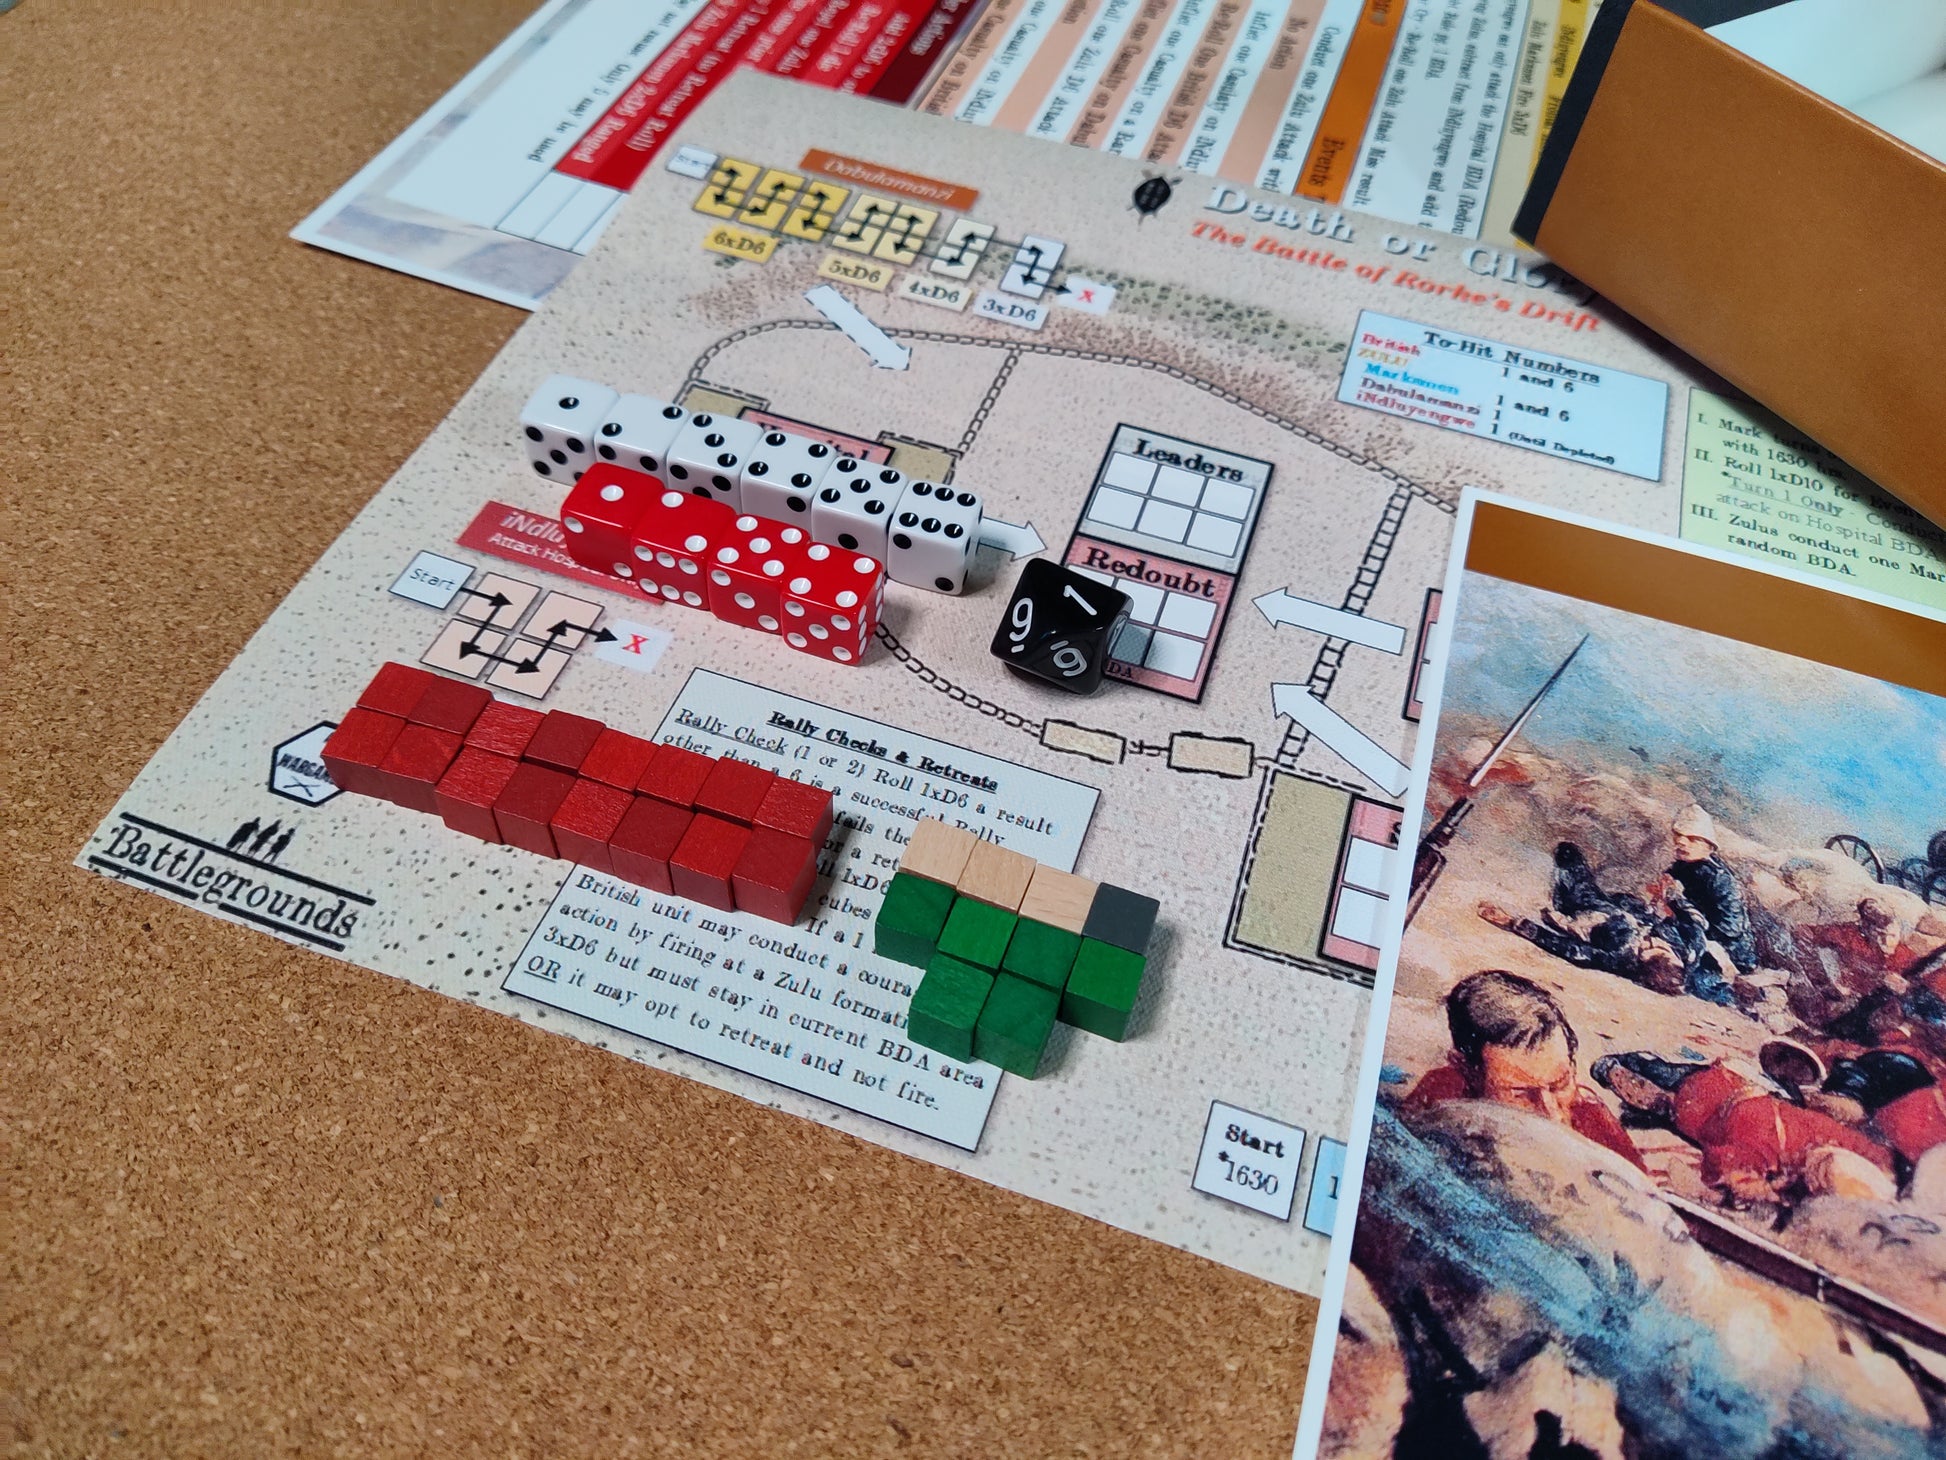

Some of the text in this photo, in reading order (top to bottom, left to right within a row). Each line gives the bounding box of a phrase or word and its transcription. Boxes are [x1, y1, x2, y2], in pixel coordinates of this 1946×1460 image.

[823, 156, 955, 201] Dabulamanzi
[1421, 195, 1438, 216] add
[1203, 183, 1355, 244] Death
[1381, 231, 1437, 263] or
[713, 232, 766, 256] 6xD6
[828, 260, 880, 284] 5xD6
[1191, 220, 1604, 333] The Battle of Rorke's Drift
[908, 281, 960, 304] 4xD6
[982, 298, 1036, 324] 3xD6
[1363, 333, 1419, 355] British
[1520, 374, 1553, 387] and
[1563, 381, 1573, 392] 6
[1504, 350, 1599, 383] Numbers
[1514, 402, 1548, 416] and
[1559, 410, 1569, 421] 6
[1717, 418, 1762, 439] Mark
[1132, 438, 1244, 483] Leaders
[1722, 439, 1758, 455] with
[1767, 448, 1809, 470] 1630
[1725, 456, 1761, 475] Roll
[1770, 468, 1823, 491] 1xD10
[1833, 484, 1858, 502] for
[1716, 494, 1770, 514] attack
[1777, 510, 1799, 523] on
[1807, 515, 1882, 545] Hospital
[1800, 495, 1843, 518] Only
[488, 533, 543, 558] Attack
[1728, 535, 1796, 559] random
[1729, 513, 1778, 536] Zulus
[1788, 533, 1858, 558] conduct
[1868, 556, 1899, 569] one
[408, 567, 455, 593] Start
[1081, 547, 1216, 598] Redoubt
[1063, 584, 1098, 616] 1
[1108, 661, 1133, 679] DA
[661, 731, 714, 756] other
[830, 785, 843, 796] a
[767, 711, 819, 739] Rally
[822, 729, 886, 758] Checks
[915, 756, 997, 792] Retreats
[674, 708, 726, 736] Rally
[730, 726, 787, 754] Check
[818, 756, 837, 767] or
[873, 768, 913, 791] Roll
[920, 782, 968, 807] 1xD6
[975, 803, 985, 814] a
[996, 809, 1051, 834] result
[832, 809, 877, 835] fails
[850, 847, 861, 859] a
[102, 822, 358, 939] Battlegrounds
[816, 892, 870, 919] cubes
[576, 874, 916, 999] British unit may conduct a coura
[805, 916, 827, 935] If
[833, 930, 844, 942] a
[559, 904, 912, 1031] action by firing at a Zulu formati
[543, 926, 983, 1088] 3xD6 but must stay in current BDA area
[524, 955, 938, 1110] OR it may opt to retreat and not fire.
[1225, 1123, 1285, 1158] Start
